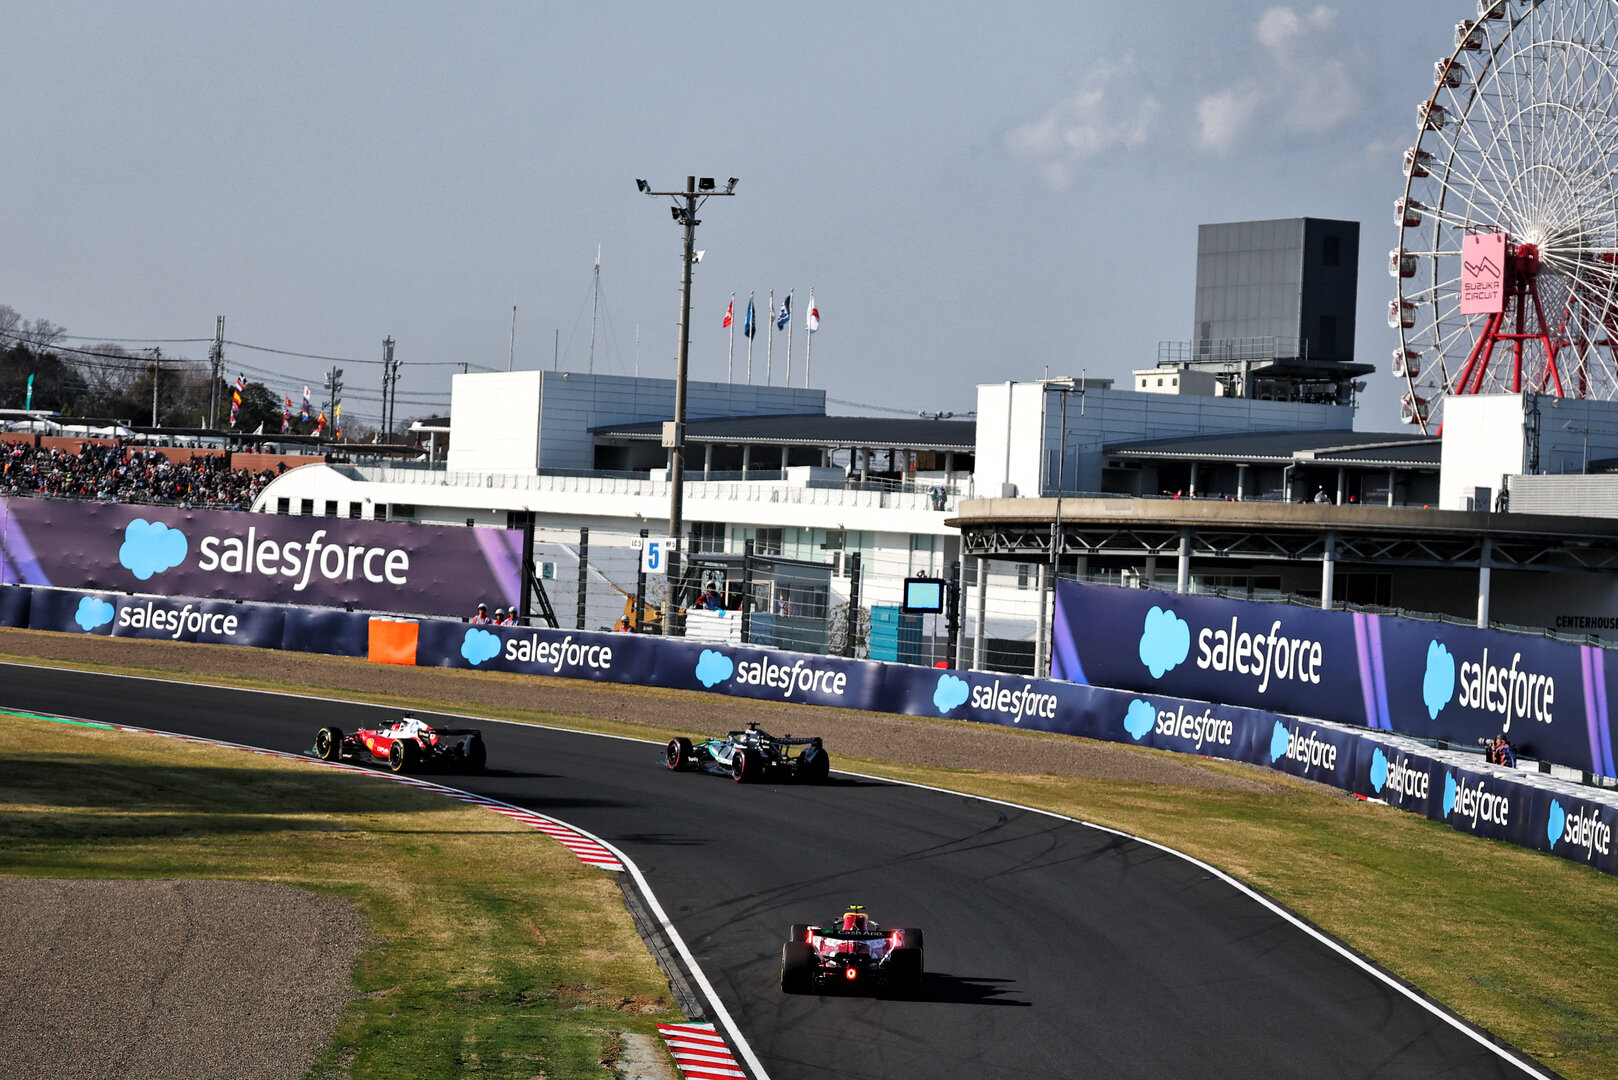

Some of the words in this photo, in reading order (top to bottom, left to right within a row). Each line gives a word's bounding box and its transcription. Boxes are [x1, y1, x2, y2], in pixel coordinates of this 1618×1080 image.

[1465, 281, 1499, 290] SUZUKA
[1465, 291, 1498, 300] CIRCUIT
[199, 526, 409, 591] salesforce
[648, 543, 659, 569] 5
[118, 601, 238, 639] salesforce
[505, 633, 612, 673] salesforce
[1197, 616, 1322, 693] salesforce
[736, 655, 847, 697] salesforce
[1459, 648, 1554, 733] salesforce
[971, 679, 1058, 723] salesforce
[1155, 705, 1233, 750] salesforce
[1286, 726, 1337, 773] alesforce
[1454, 776, 1509, 829] alesforce
